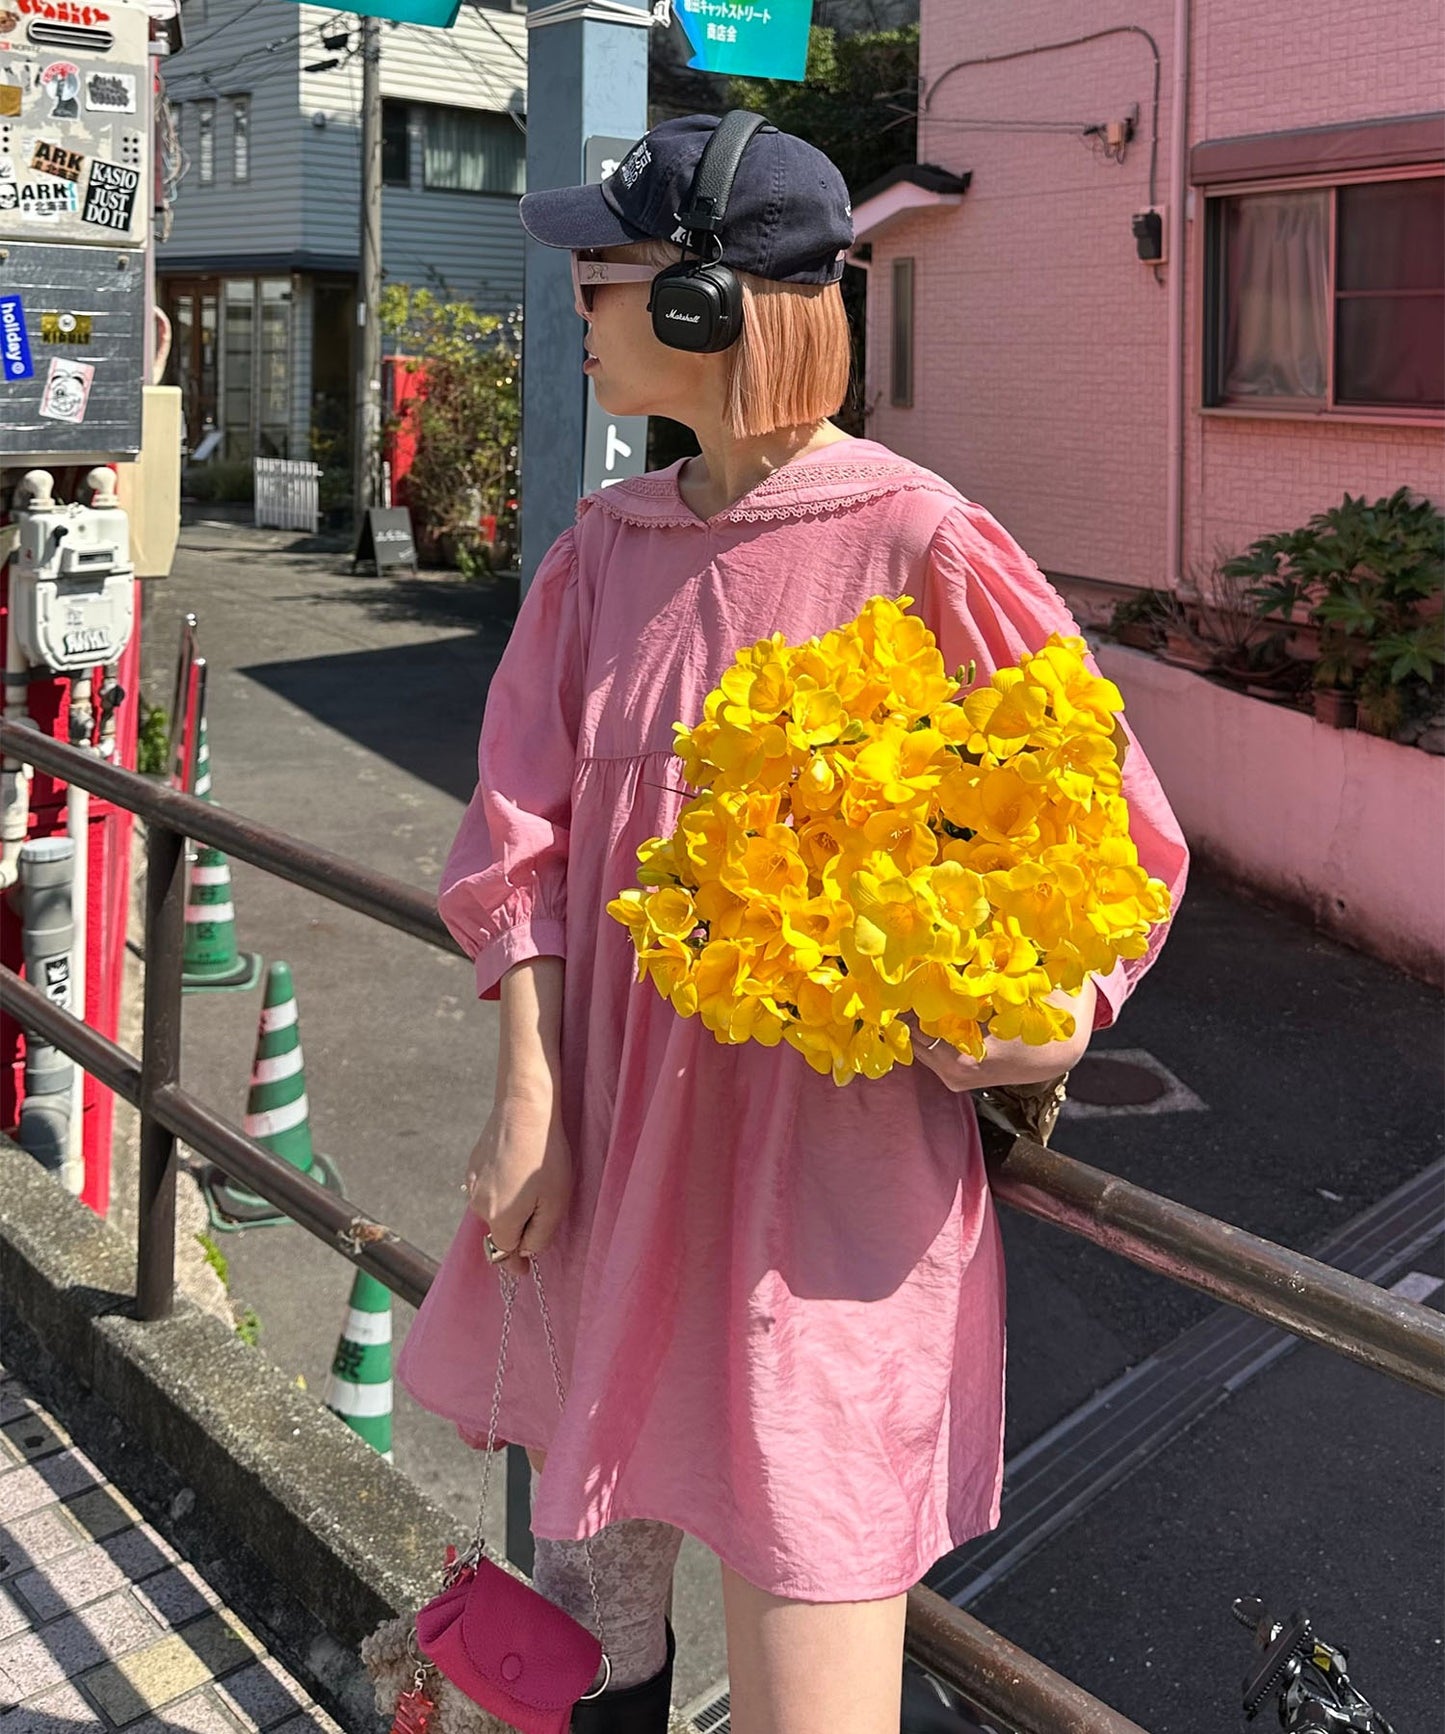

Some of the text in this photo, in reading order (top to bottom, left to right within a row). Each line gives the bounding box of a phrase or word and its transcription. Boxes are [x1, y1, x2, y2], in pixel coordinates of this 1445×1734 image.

[707, 22, 737, 43] 商店会
[35, 142, 84, 171] ARK
[21, 183, 68, 200] ARK
[90, 187, 130, 211] JUST
[86, 203, 129, 228] DO IT
[665, 308, 701, 324] Marshall
[1, 302, 22, 361] holiday
